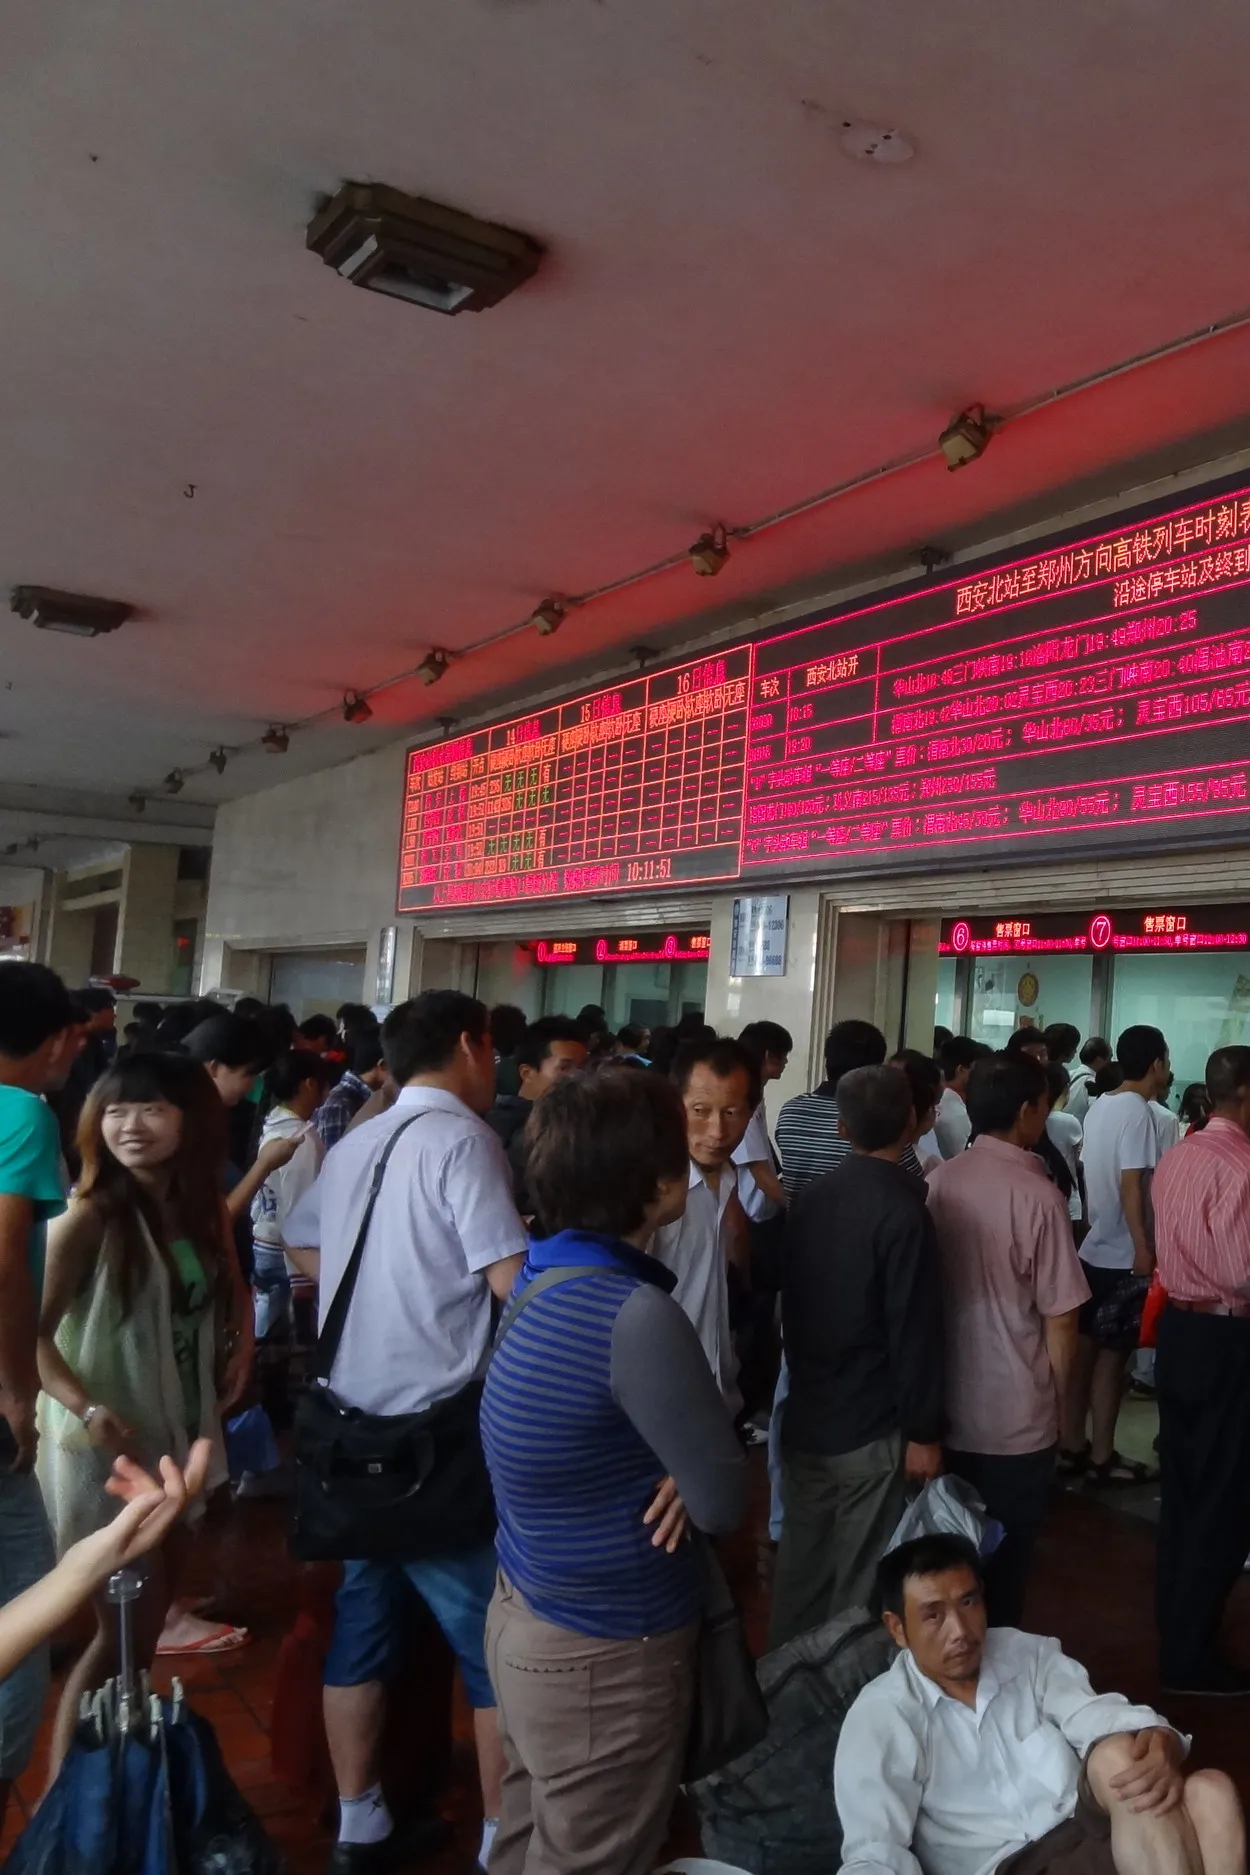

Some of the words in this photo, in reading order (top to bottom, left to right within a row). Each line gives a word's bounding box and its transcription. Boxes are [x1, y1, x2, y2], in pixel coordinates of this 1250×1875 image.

[806, 655, 858, 687] 西安北站开
[760, 677, 780, 698] 车次
[627, 858, 671, 882] 10:11:51
[995, 921, 1031, 938] 售票窗口
[1144, 914, 1187, 933] 售票窗口
